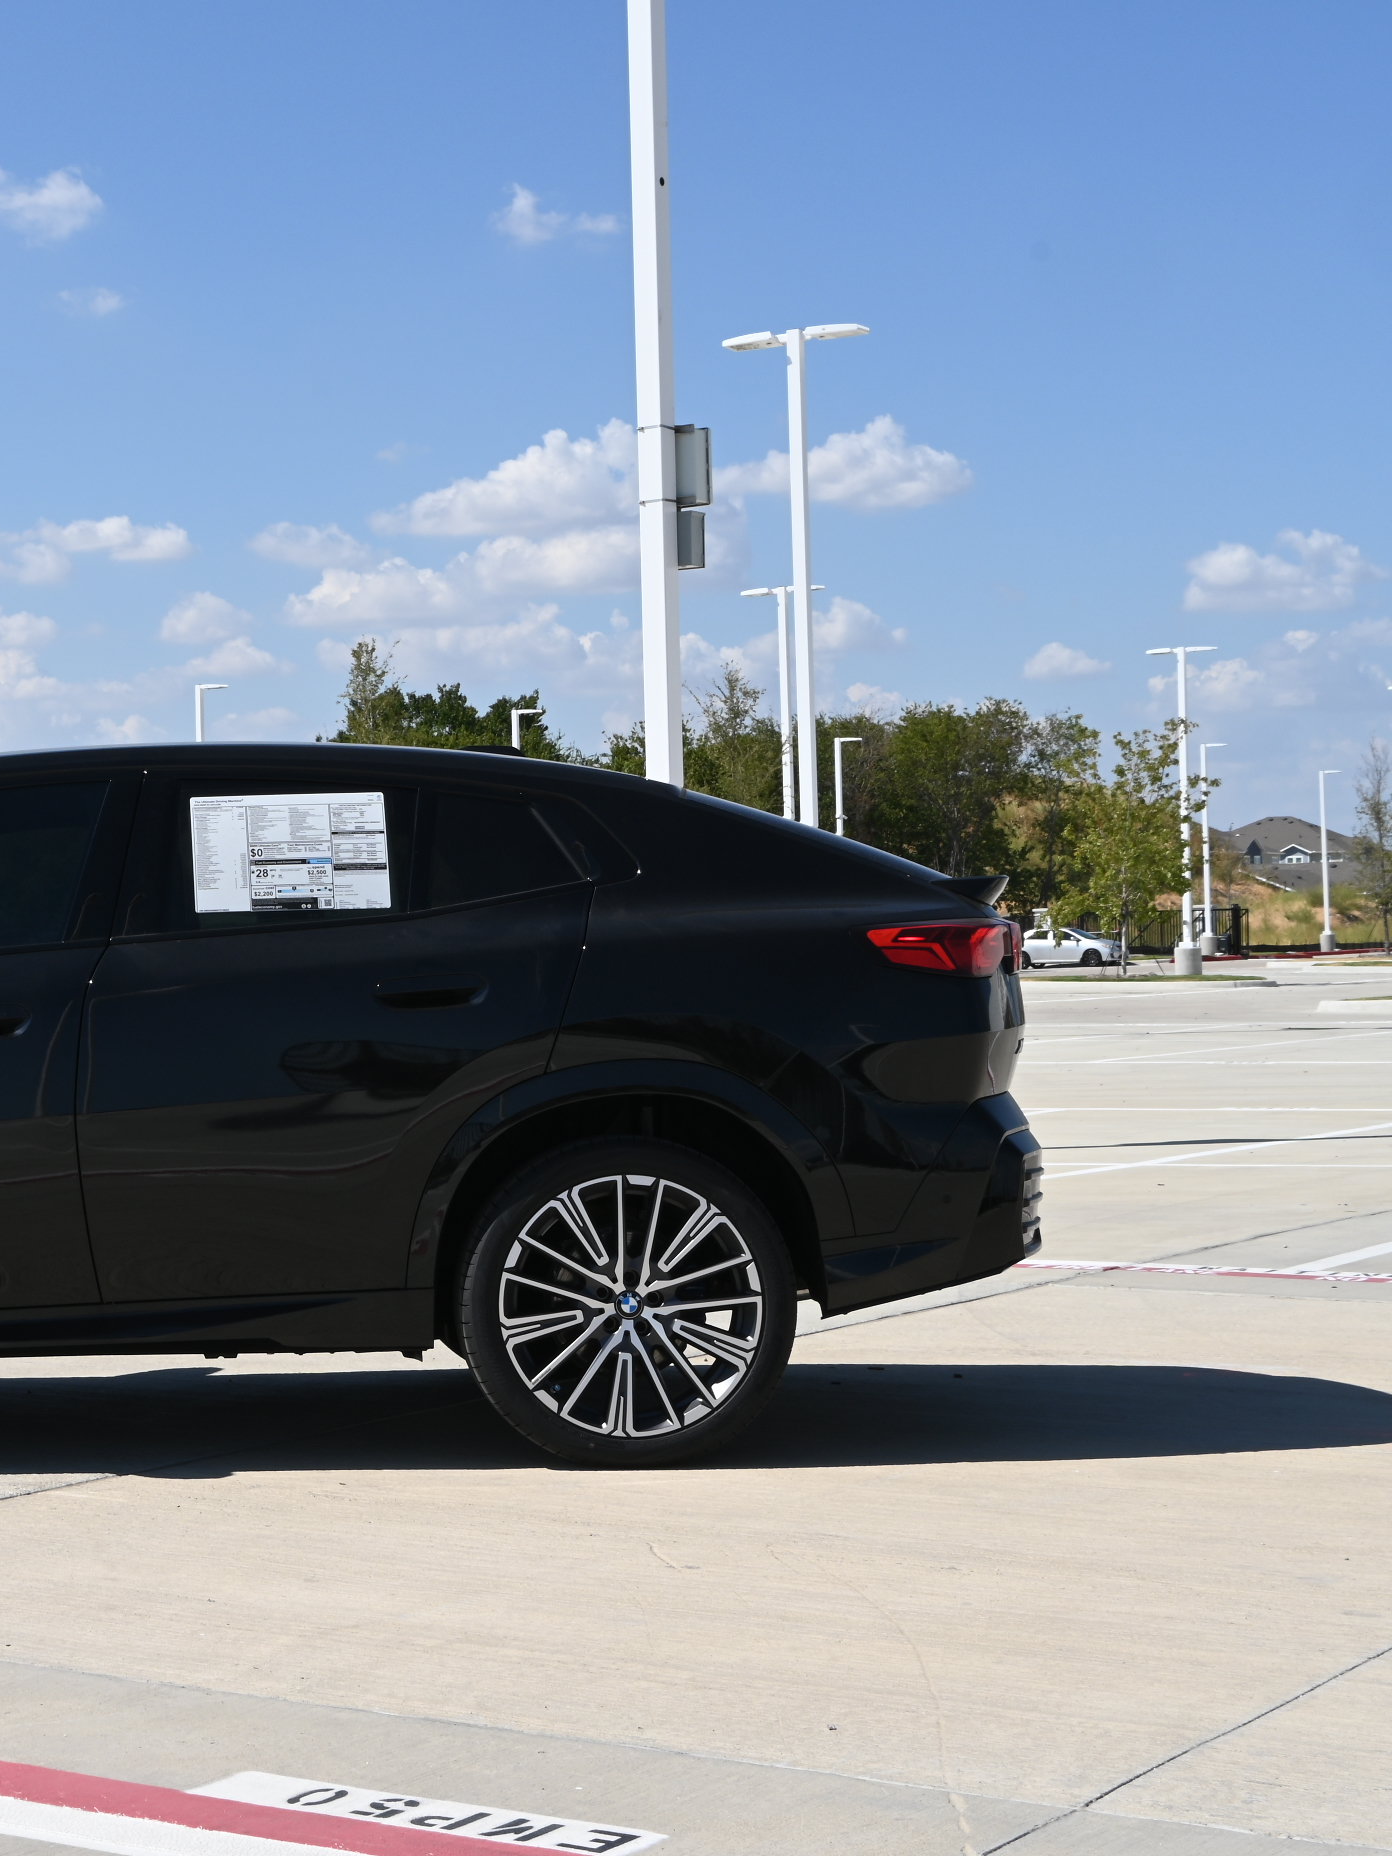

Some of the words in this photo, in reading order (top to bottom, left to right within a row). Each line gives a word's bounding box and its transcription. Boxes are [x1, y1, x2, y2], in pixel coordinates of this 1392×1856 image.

[250, 848, 263, 858] $0
[255, 868, 269, 878] 28
[286, 1787, 641, 1855] EMP50
